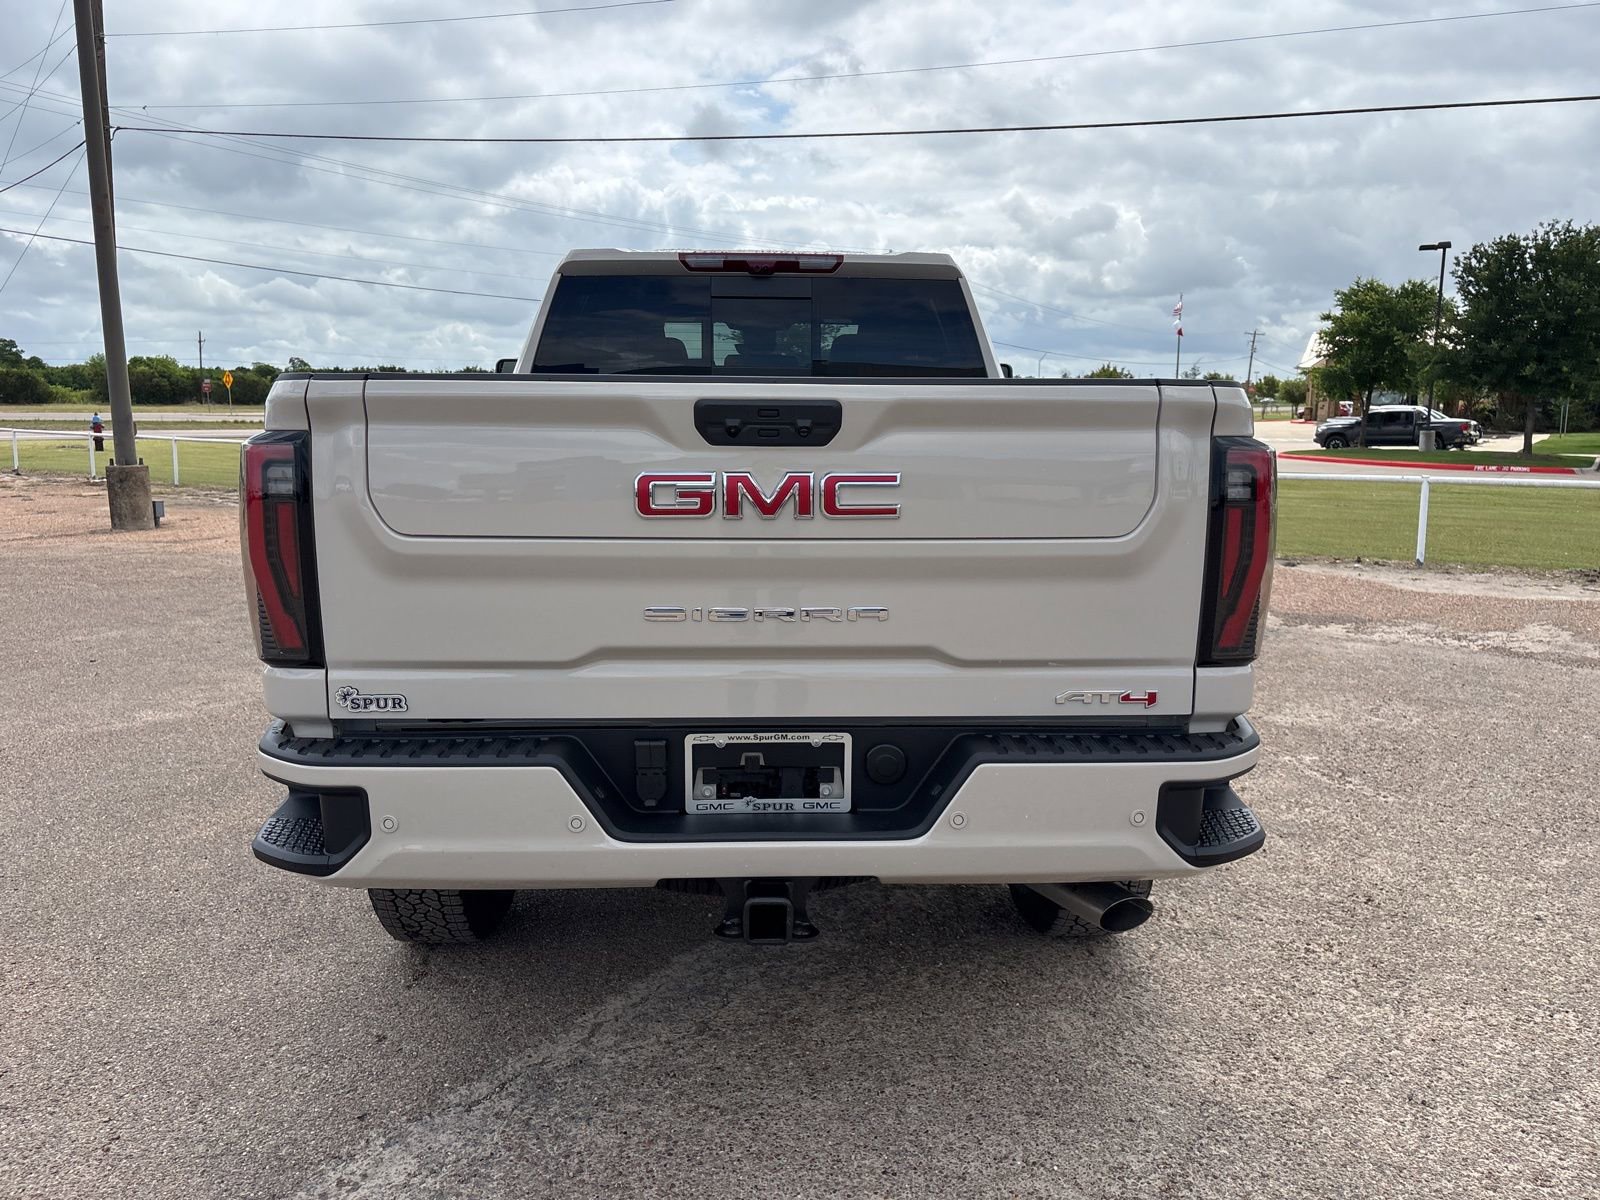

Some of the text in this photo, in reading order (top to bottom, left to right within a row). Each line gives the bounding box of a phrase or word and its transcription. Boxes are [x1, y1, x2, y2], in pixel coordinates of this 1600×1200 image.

[634, 471, 902, 520] GMC
[643, 606, 889, 622] SIERRA
[350, 697, 404, 710] SPUR
[1055, 690, 1158, 709] AT4
[727, 734, 810, 742] www.SpurGM.com
[696, 802, 841, 811] GMC SPUR GMC
